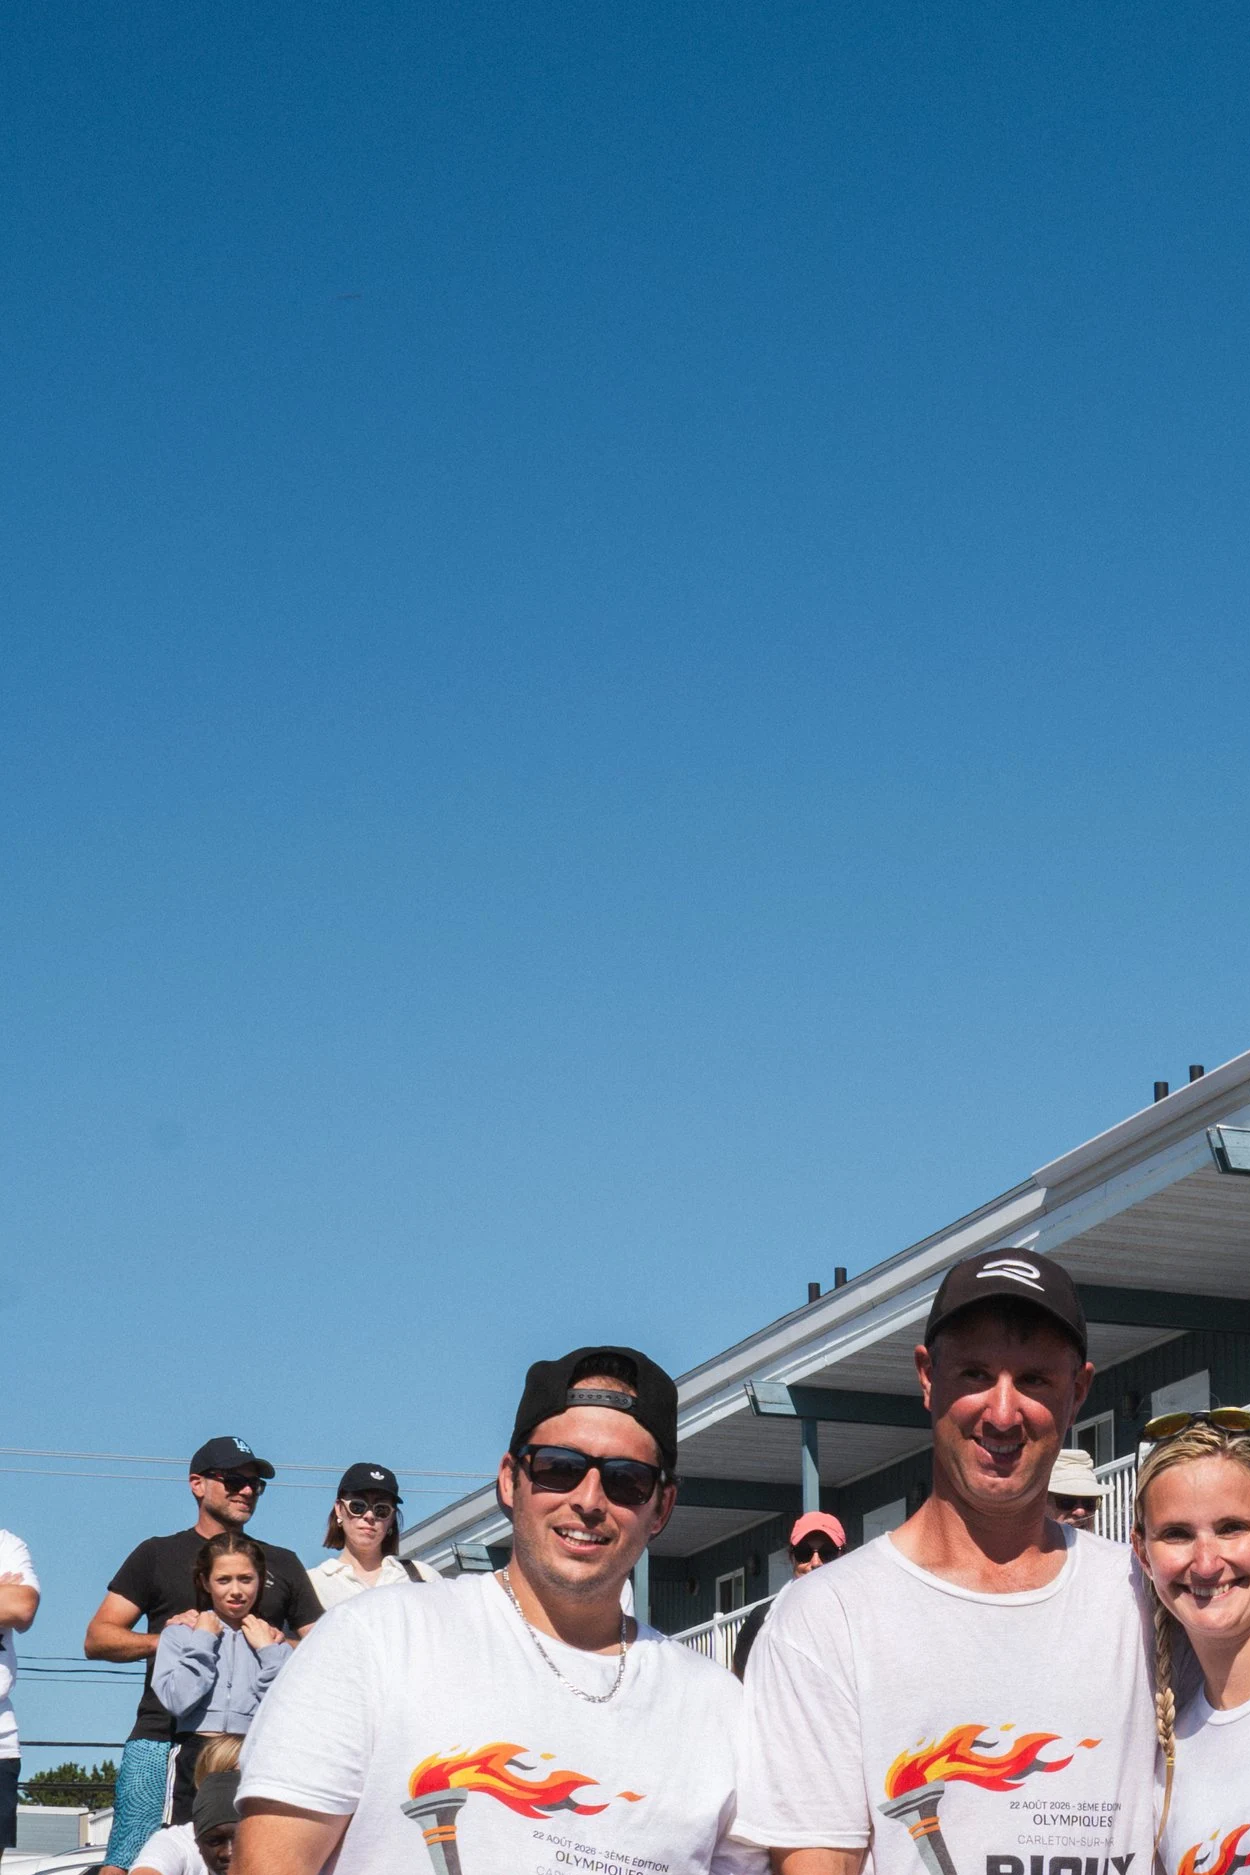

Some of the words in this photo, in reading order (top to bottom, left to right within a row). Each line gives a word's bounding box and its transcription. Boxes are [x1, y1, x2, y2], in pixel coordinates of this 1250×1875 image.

[1009, 1801, 1020, 1809] 22
[1022, 1799, 1046, 1810] AOÛT
[1050, 1802, 1070, 1810] 2026
[1033, 1814, 1113, 1827] OLYMPIQUES
[533, 1830, 544, 1841] 22
[546, 1833, 573, 1849] AOÛT
[574, 1843, 597, 1856] 2026
[603, 1849, 631, 1864] 3ÈME
[632, 1855, 669, 1873] ÉDITION
